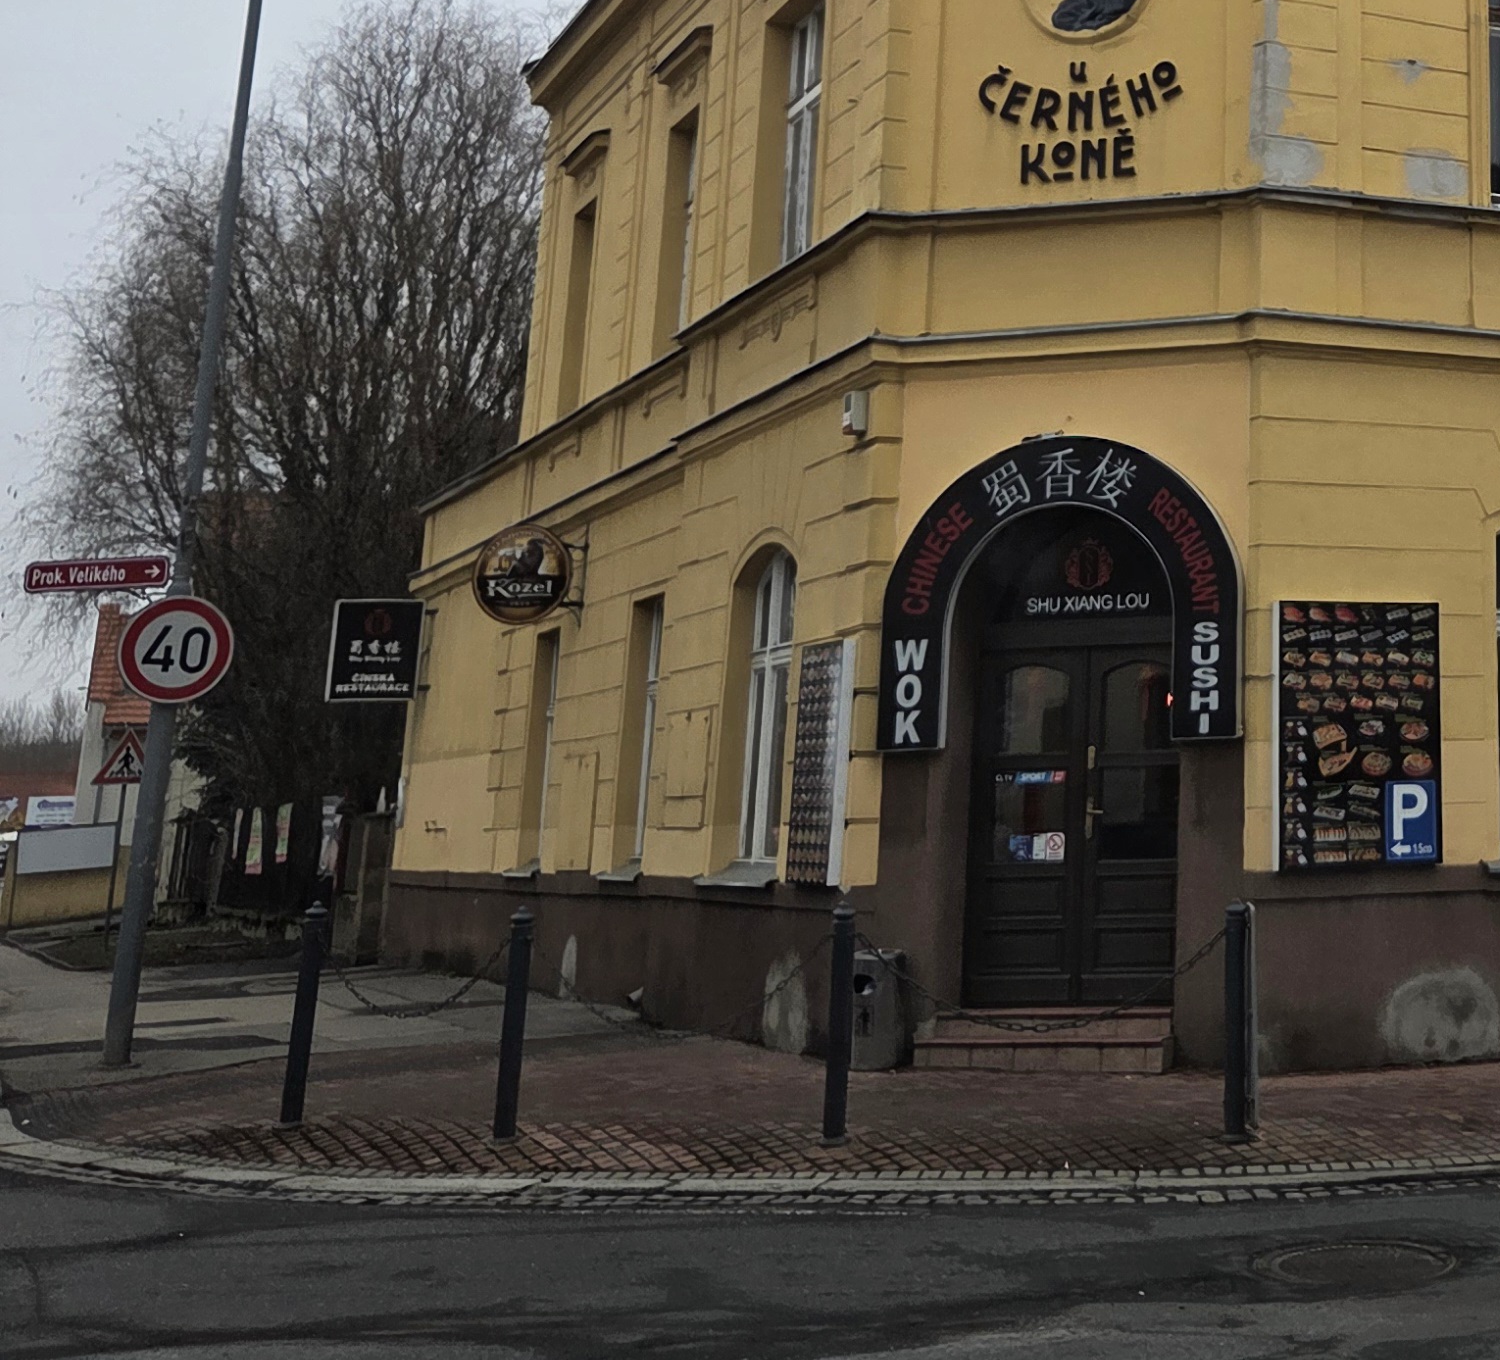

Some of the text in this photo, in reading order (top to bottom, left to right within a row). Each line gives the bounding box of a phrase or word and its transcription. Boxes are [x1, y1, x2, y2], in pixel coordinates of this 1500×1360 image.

[978, 61, 1183, 132] ČERNÉHO
[1020, 128, 1137, 185] KONĚ
[981, 447, 1138, 517] 蜀香楼
[31, 566, 126, 586] Prok. Velikého
[902, 501, 974, 616] CHINESE
[1147, 487, 1220, 614] RESTAURANT
[486, 578, 553, 598] Kozel
[1026, 593, 1150, 614] SHU XIANG LOU
[141, 625, 211, 674] 40
[1190, 621, 1220, 734] SUSHI
[894, 638, 928, 744] WOK
[1393, 783, 1428, 841] P
